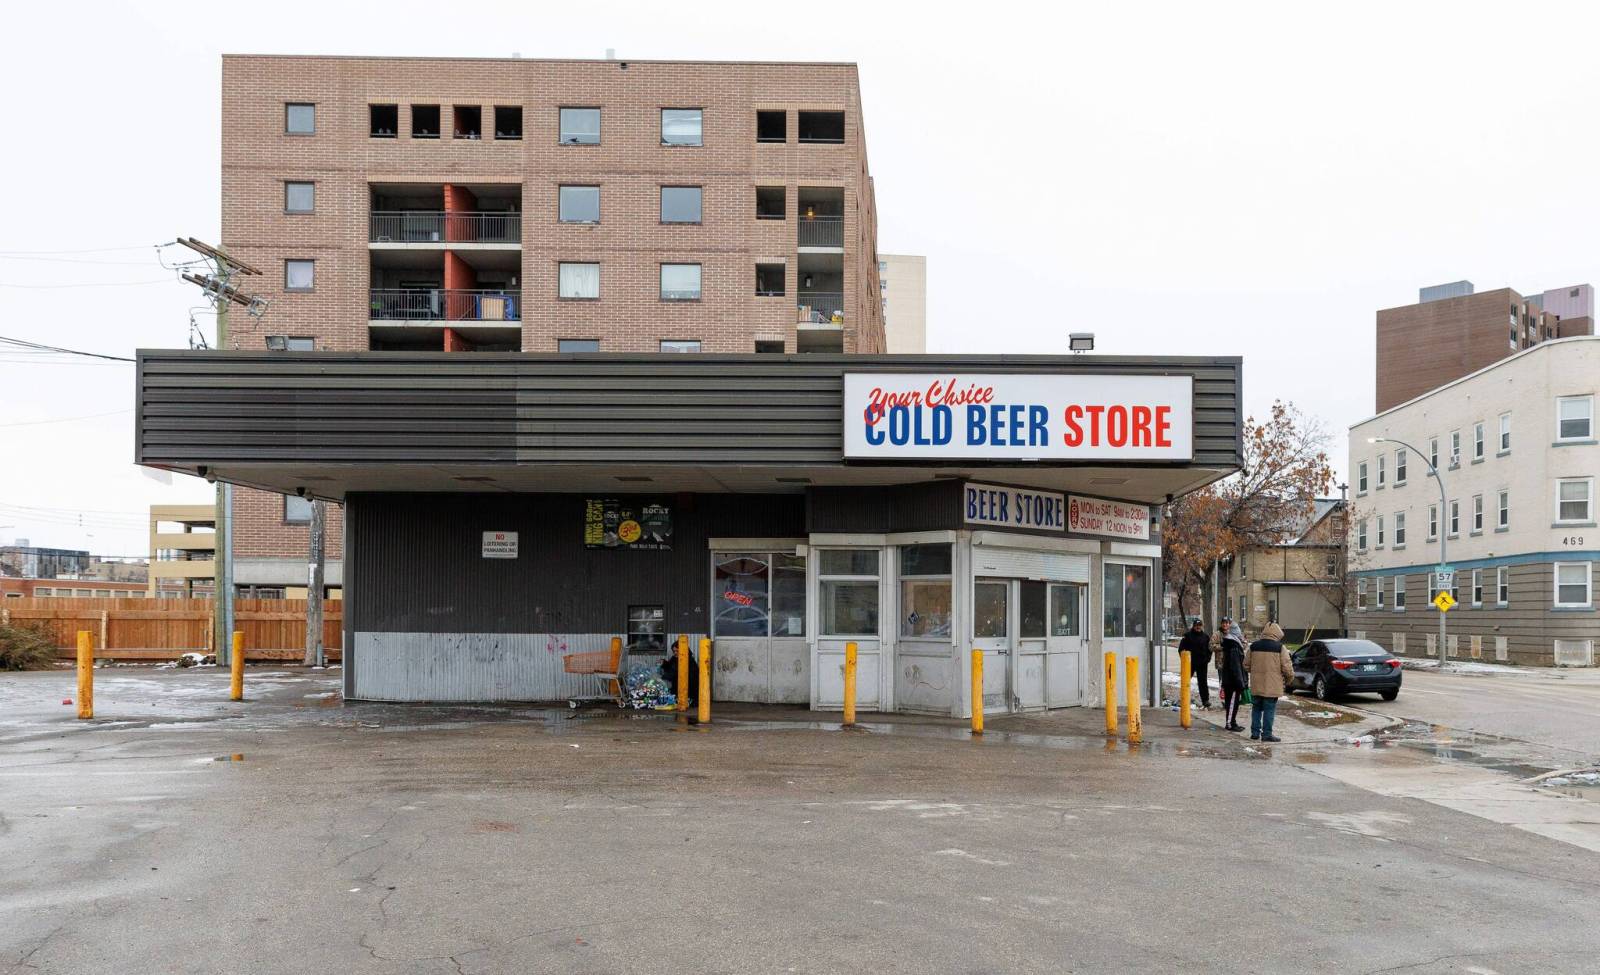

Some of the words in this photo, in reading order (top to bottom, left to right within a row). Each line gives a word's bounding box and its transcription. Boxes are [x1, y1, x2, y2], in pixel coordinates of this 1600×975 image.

[864, 388, 923, 426] Your
[925, 378, 994, 408] Choice
[865, 404, 953, 446] COLD
[966, 405, 1049, 446] BEER
[1064, 405, 1172, 447] STORE
[966, 488, 1009, 523] BEER
[1015, 492, 1064, 528] STORE
[1080, 501, 1095, 514] MON
[1095, 506, 1101, 515] to
[1101, 503, 1111, 516] SAT
[1113, 505, 1125, 518] 9AM
[1080, 517, 1104, 530] SUNDAY
[1106, 519, 1113, 532] 12
[1113, 522, 1127, 533] NOON
[495, 533, 505, 541] NO
[592, 523, 604, 544] KING
[1562, 536, 1584, 546] 469
[1439, 573, 1451, 581] 57
[724, 591, 752, 607] OPEN
